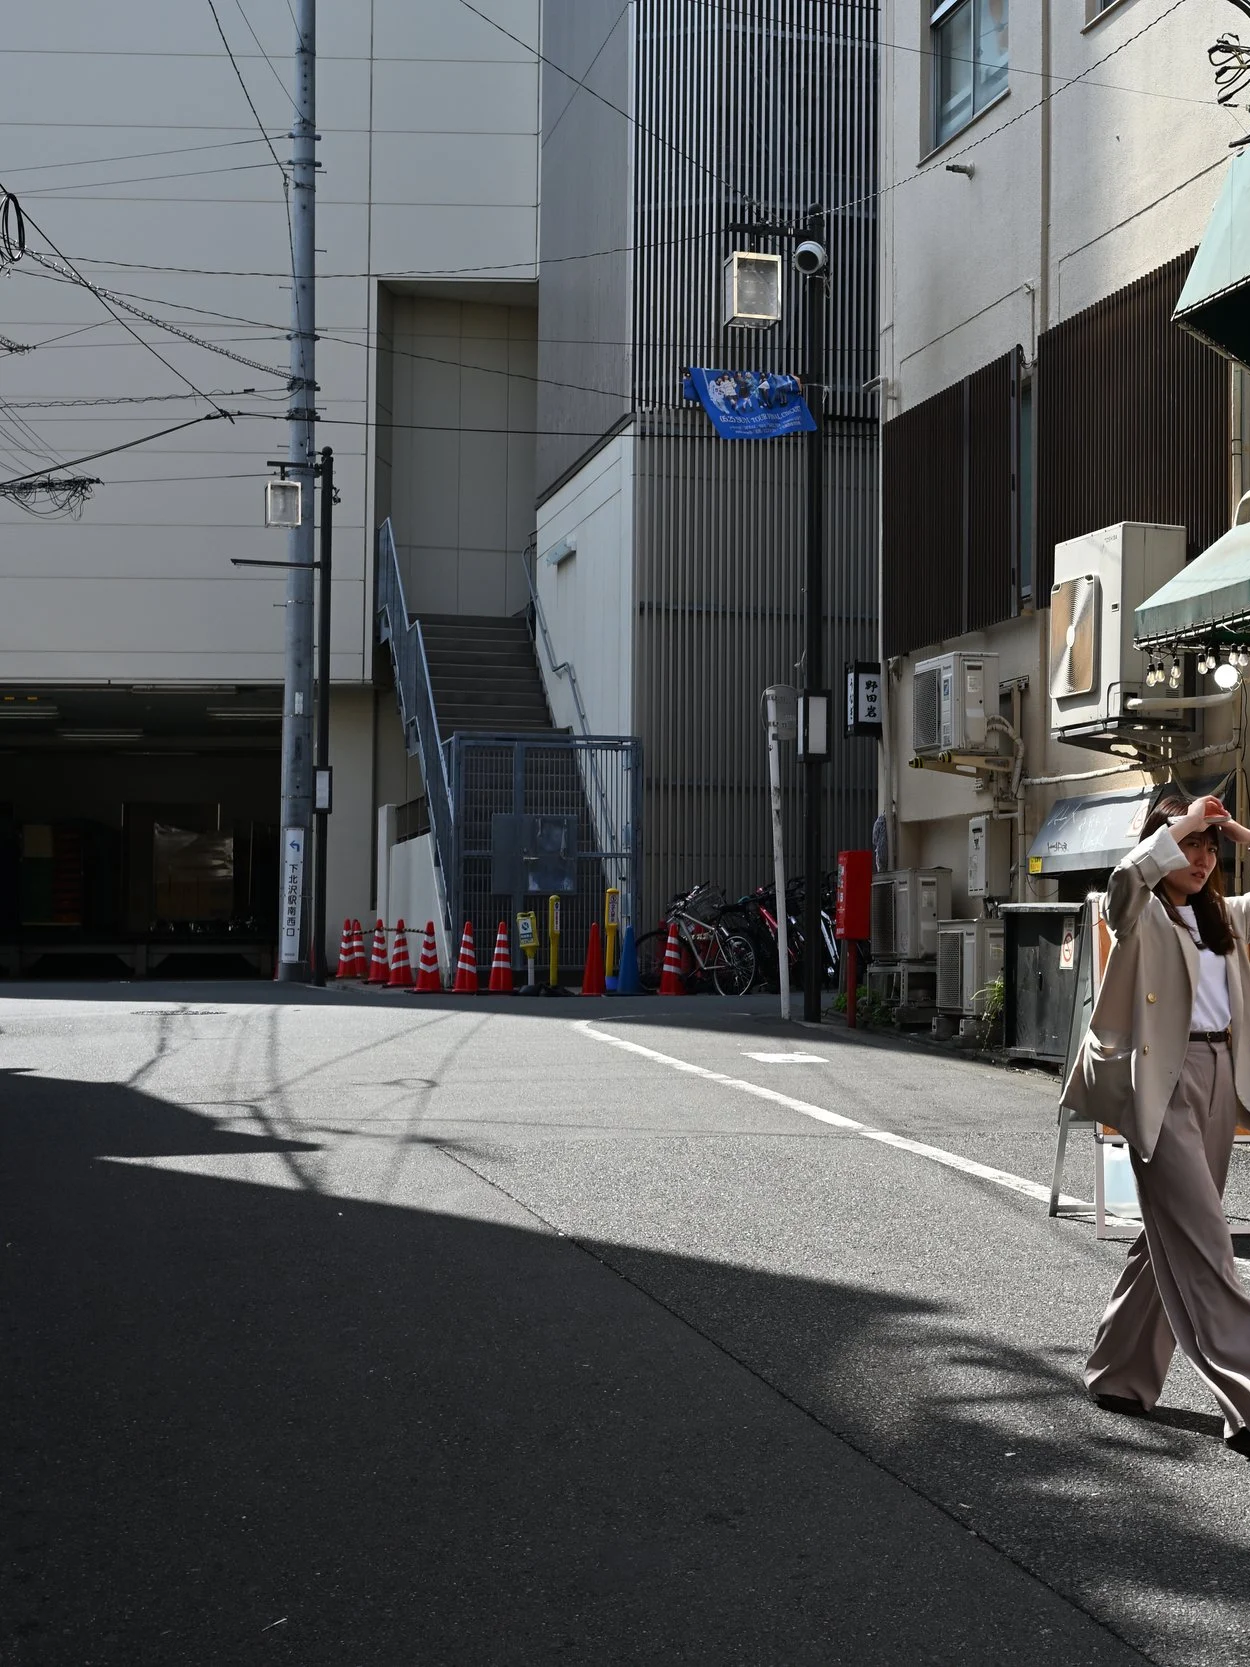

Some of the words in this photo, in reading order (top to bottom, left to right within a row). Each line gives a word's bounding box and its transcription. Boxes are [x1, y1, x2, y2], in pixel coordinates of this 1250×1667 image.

[865, 680, 879, 718] 野田岩
[286, 863, 298, 937] 下北沢駅南西口
